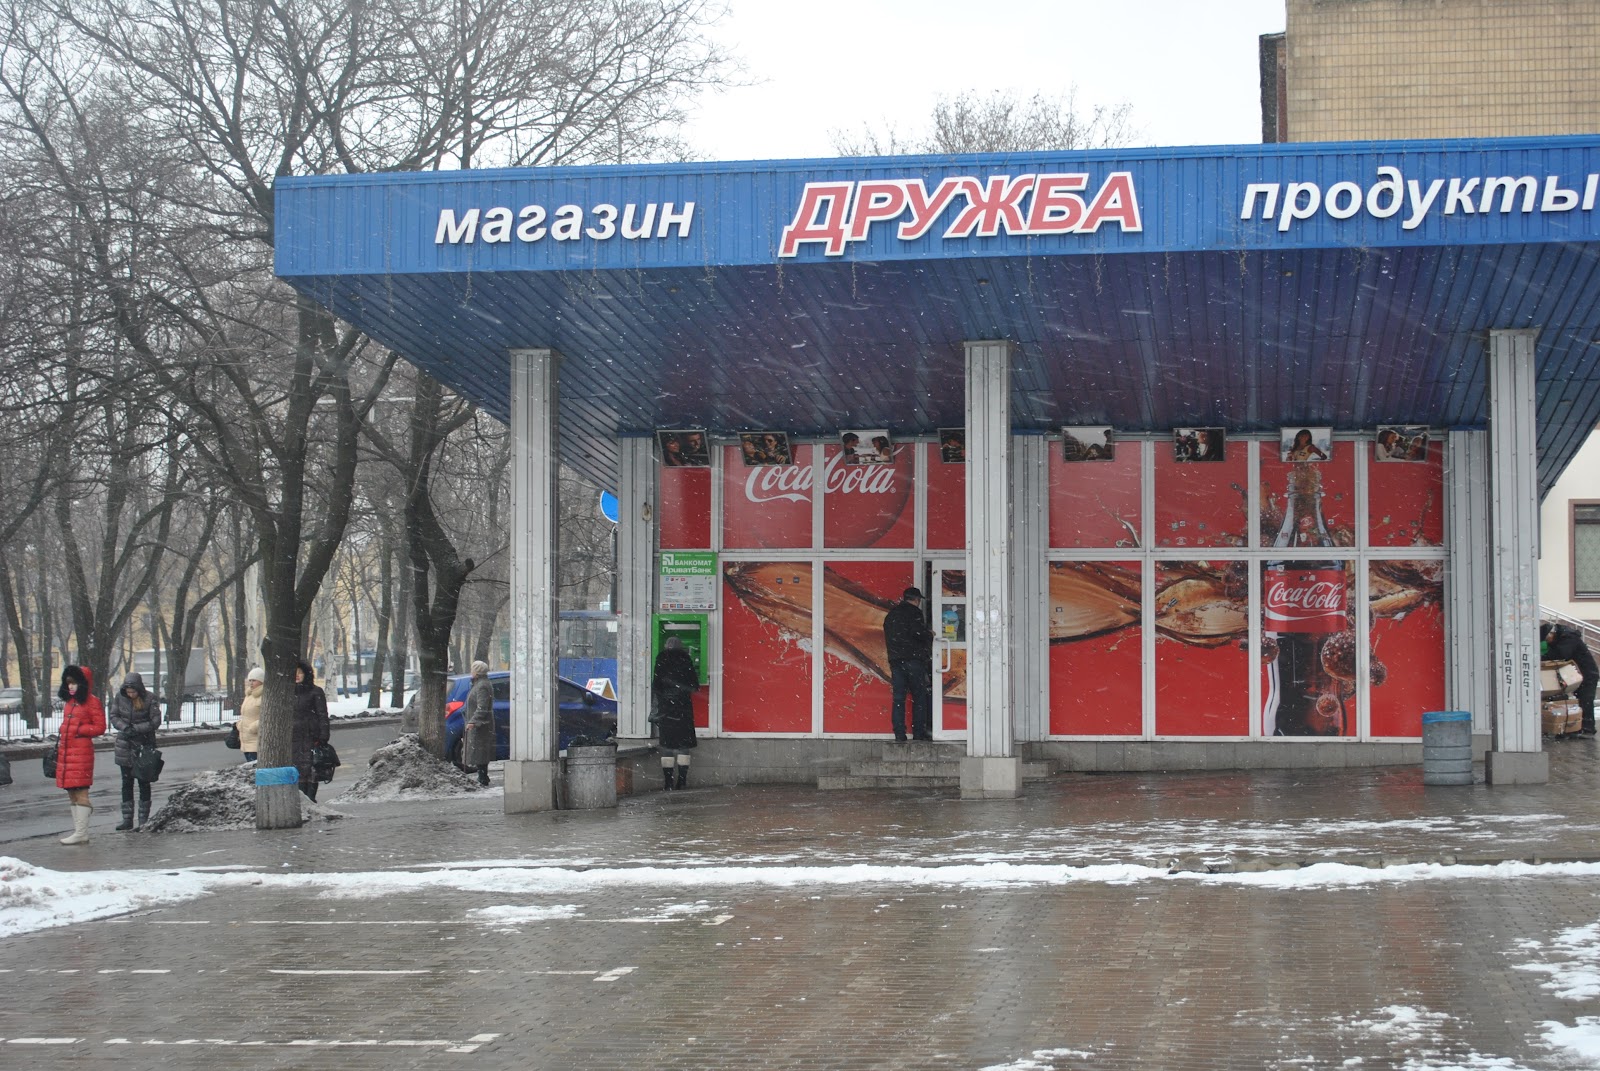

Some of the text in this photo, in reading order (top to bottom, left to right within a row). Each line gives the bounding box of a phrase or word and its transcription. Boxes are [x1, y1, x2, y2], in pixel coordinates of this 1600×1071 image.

[777, 171, 1143, 258] ДРУЖБА
[1240, 165, 1600, 232] продукты
[435, 200, 695, 245] магазин
[662, 566, 712, 574] ПриватБанк
[1267, 581, 1345, 609] Coca-Cola
